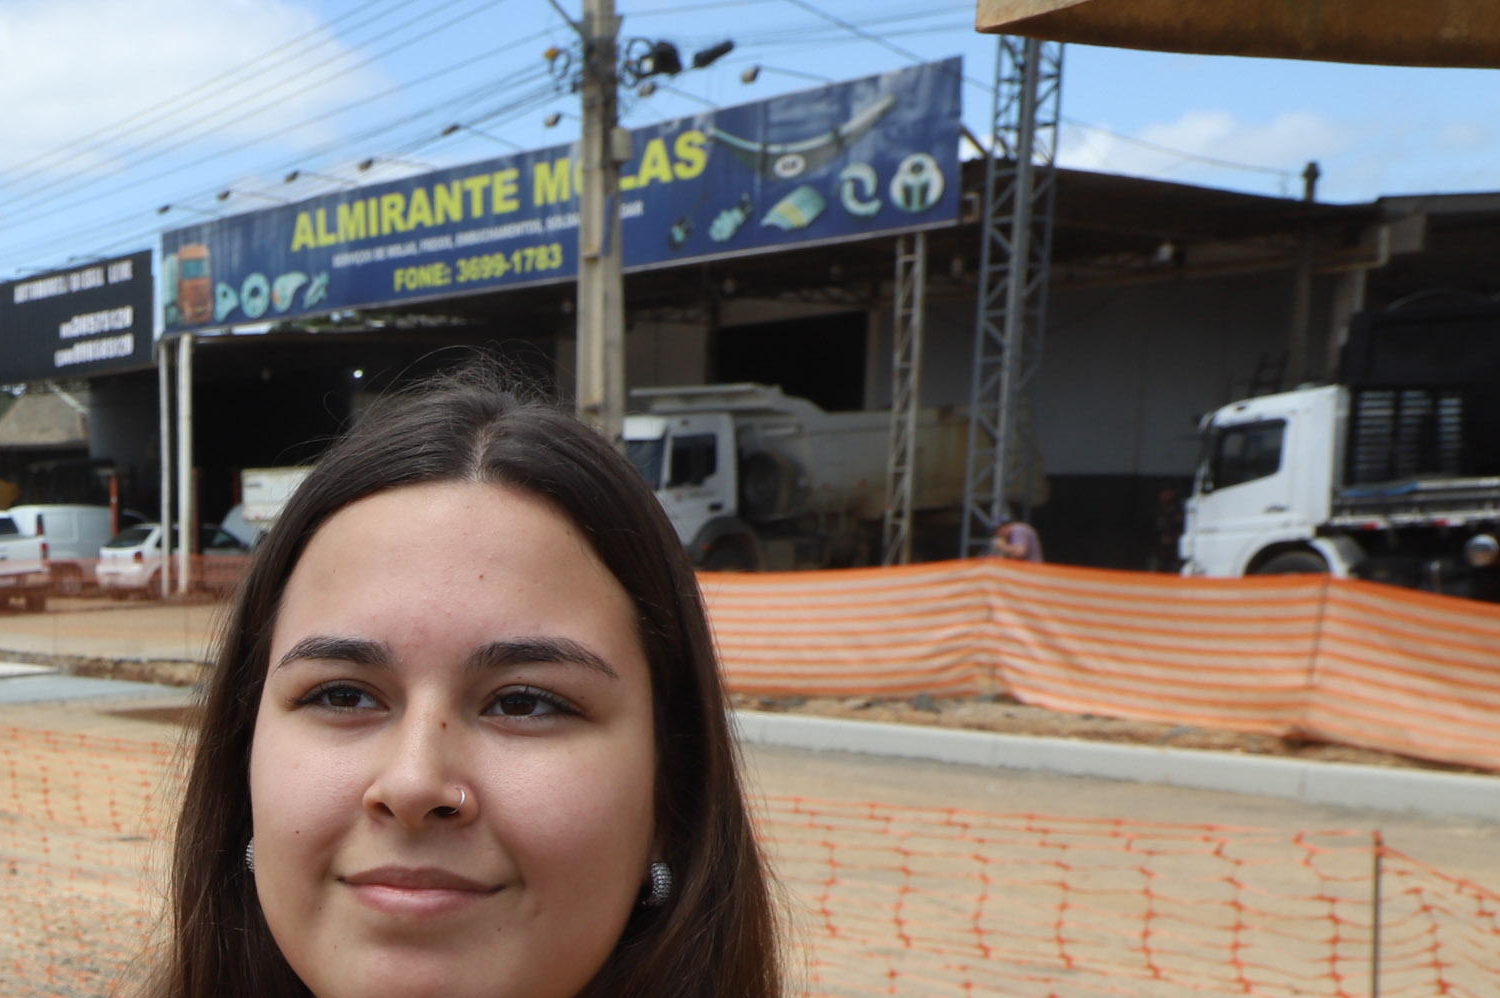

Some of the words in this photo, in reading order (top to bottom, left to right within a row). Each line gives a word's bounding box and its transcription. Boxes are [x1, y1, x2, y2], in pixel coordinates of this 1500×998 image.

[290, 167, 521, 252] ALMIRANTE
[533, 130, 709, 207] MAS
[393, 260, 452, 292] FONE:
